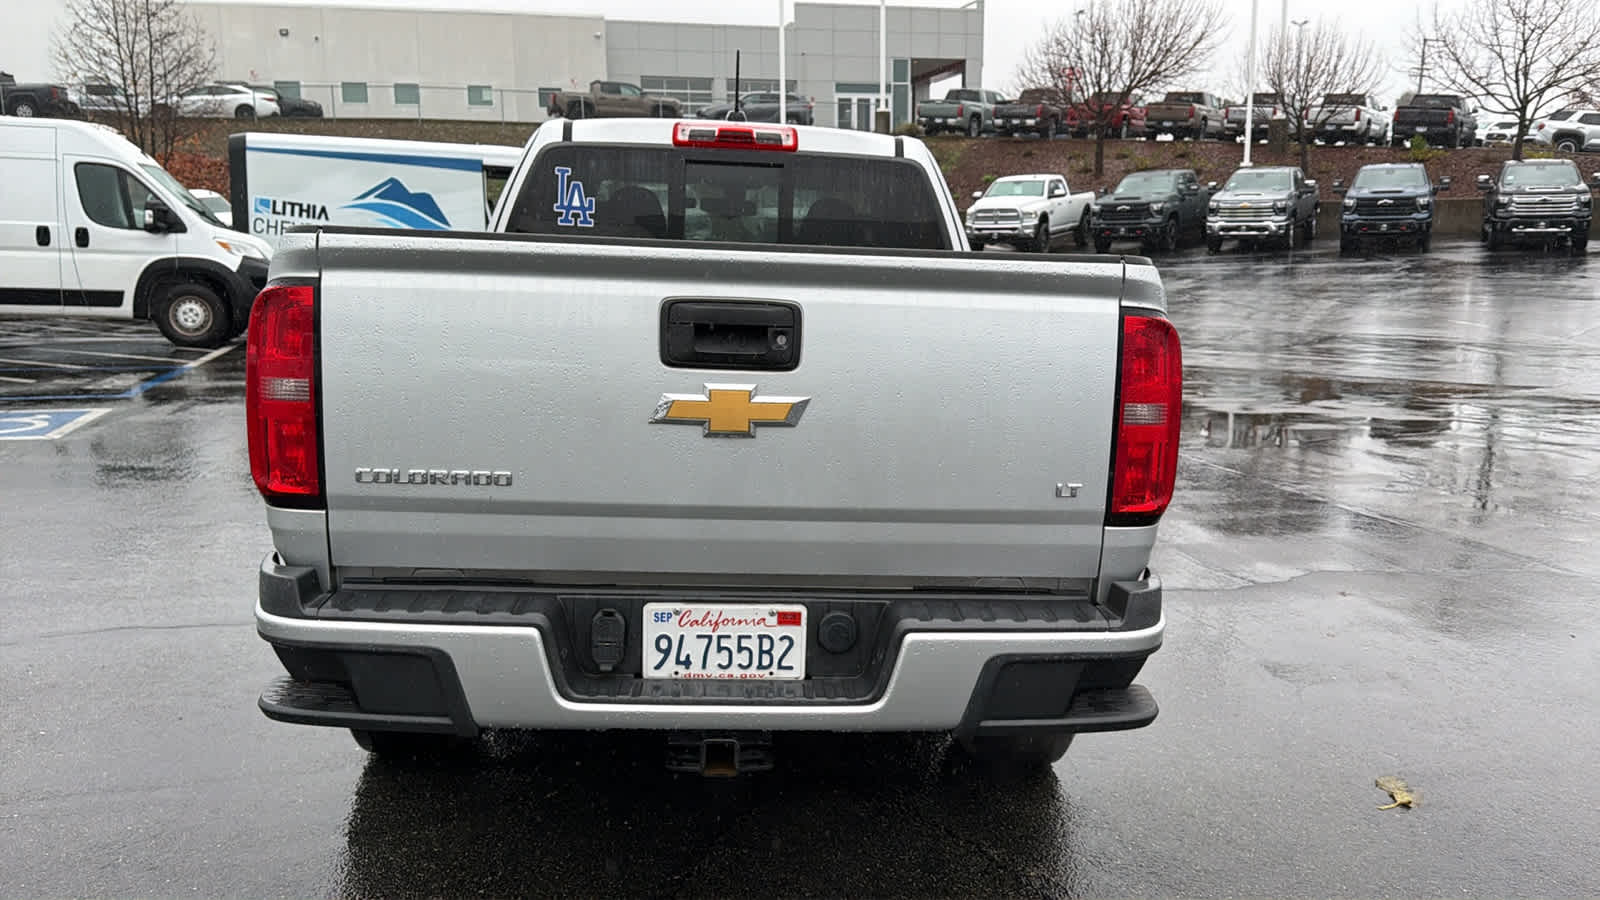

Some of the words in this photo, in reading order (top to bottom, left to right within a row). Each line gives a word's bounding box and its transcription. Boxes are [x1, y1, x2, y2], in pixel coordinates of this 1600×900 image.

[554, 167, 595, 227] LA
[272, 200, 329, 221] LITHIA
[355, 467, 513, 487] COLORADO
[1056, 482, 1083, 498] LT
[653, 611, 673, 623] SEP
[678, 609, 777, 633] California
[653, 633, 795, 671] 94755B2
[683, 671, 766, 680] dmv.ca.gov
